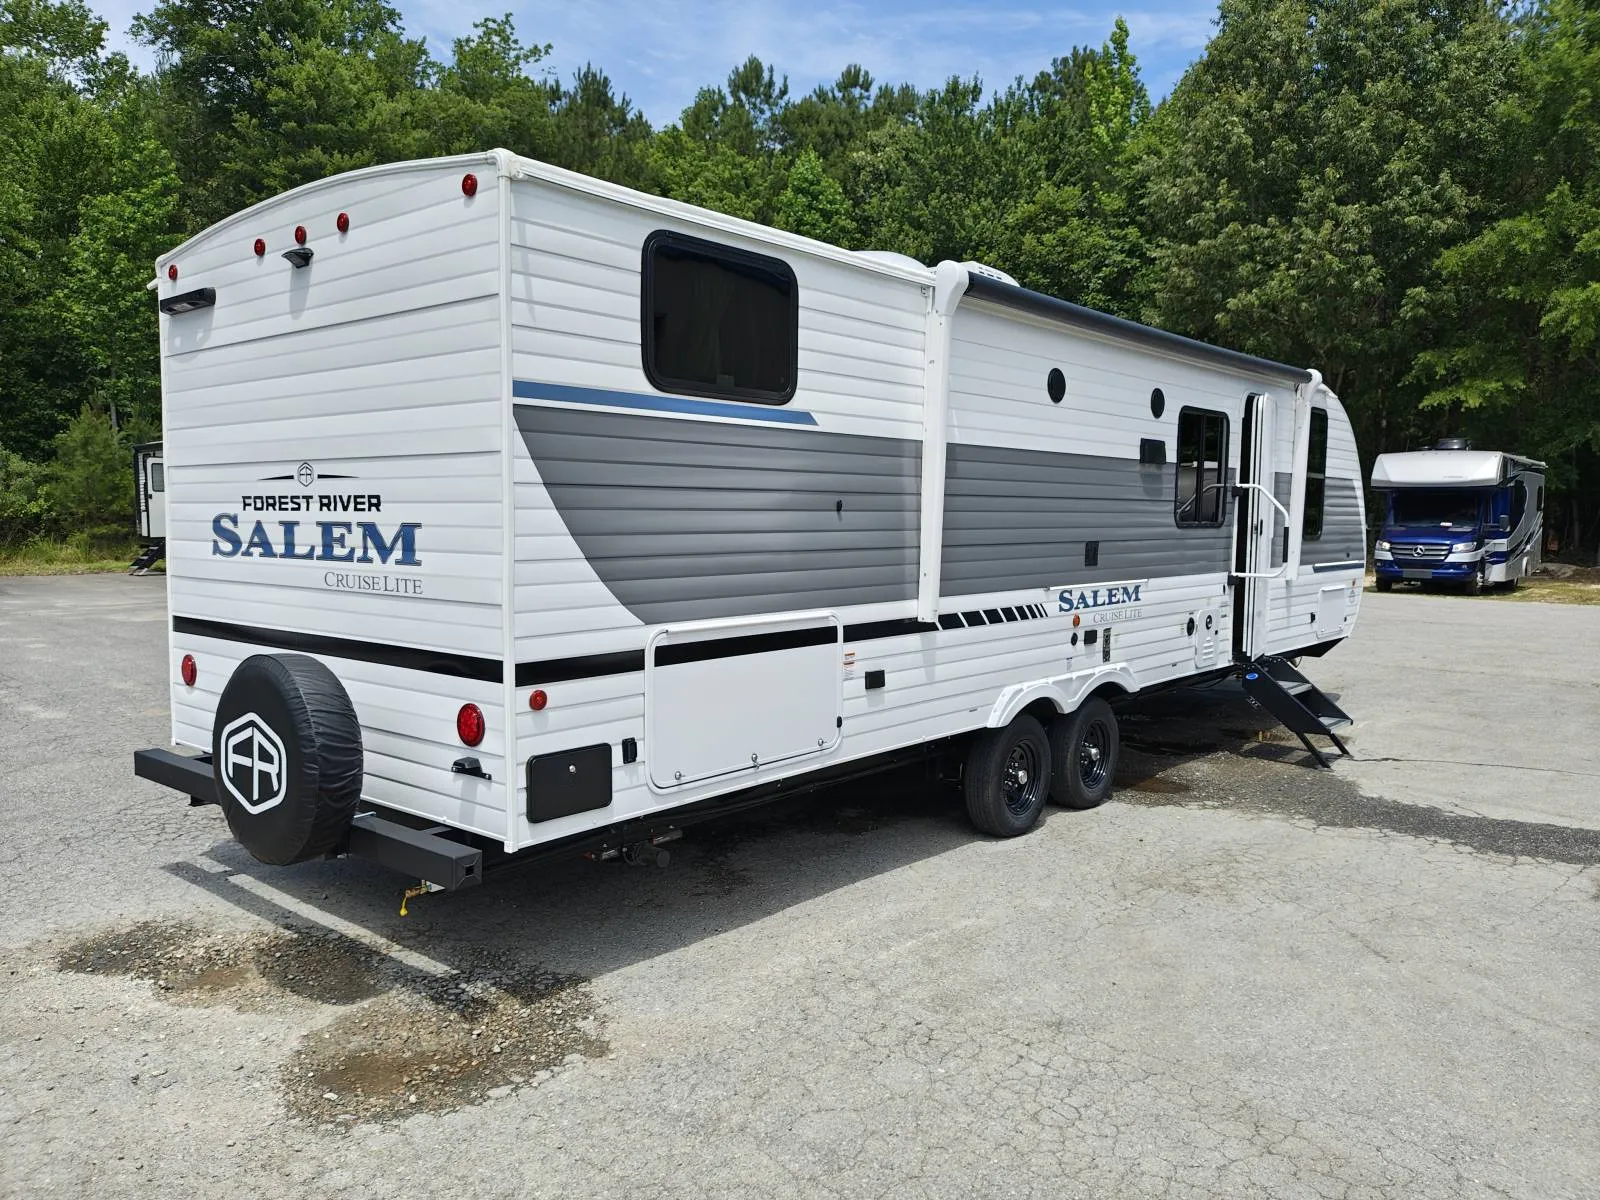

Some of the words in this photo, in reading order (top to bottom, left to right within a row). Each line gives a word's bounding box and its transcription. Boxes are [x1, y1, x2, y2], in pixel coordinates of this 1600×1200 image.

[242, 495, 313, 511] FOREST
[318, 494, 381, 512] RIVER
[212, 512, 422, 566] SALEM
[1058, 585, 1141, 612] SALEM
